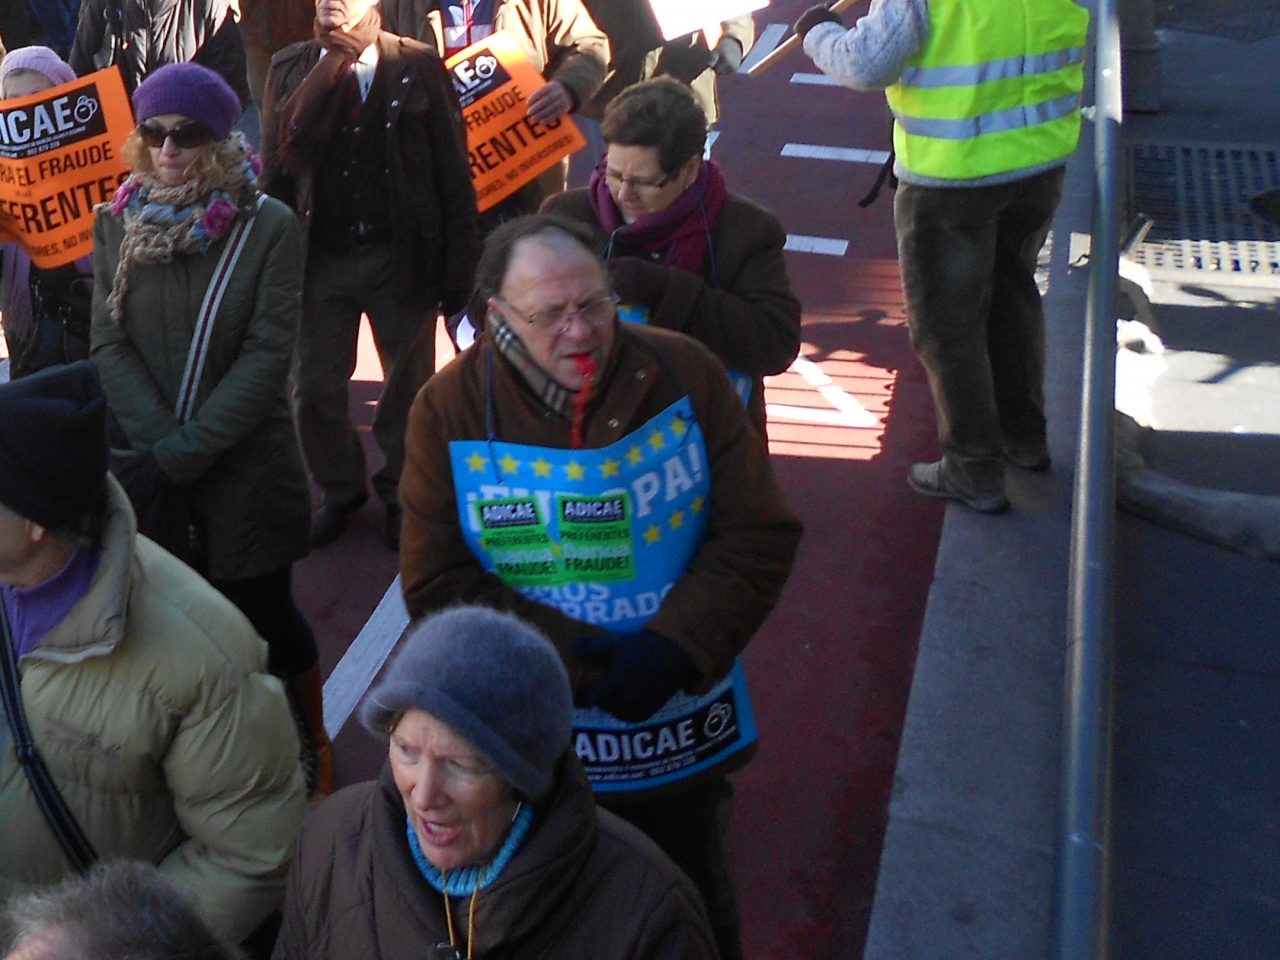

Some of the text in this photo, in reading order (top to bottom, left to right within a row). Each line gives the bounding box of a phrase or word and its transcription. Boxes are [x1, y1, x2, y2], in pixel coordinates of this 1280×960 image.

[18, 170, 36, 188] EL
[38, 140, 114, 181] FRAUDE
[483, 502, 536, 524] ADICAE
[565, 499, 624, 518] ADICAE
[565, 557, 630, 572] FRAUDE!
[575, 718, 696, 763] ADICAE
